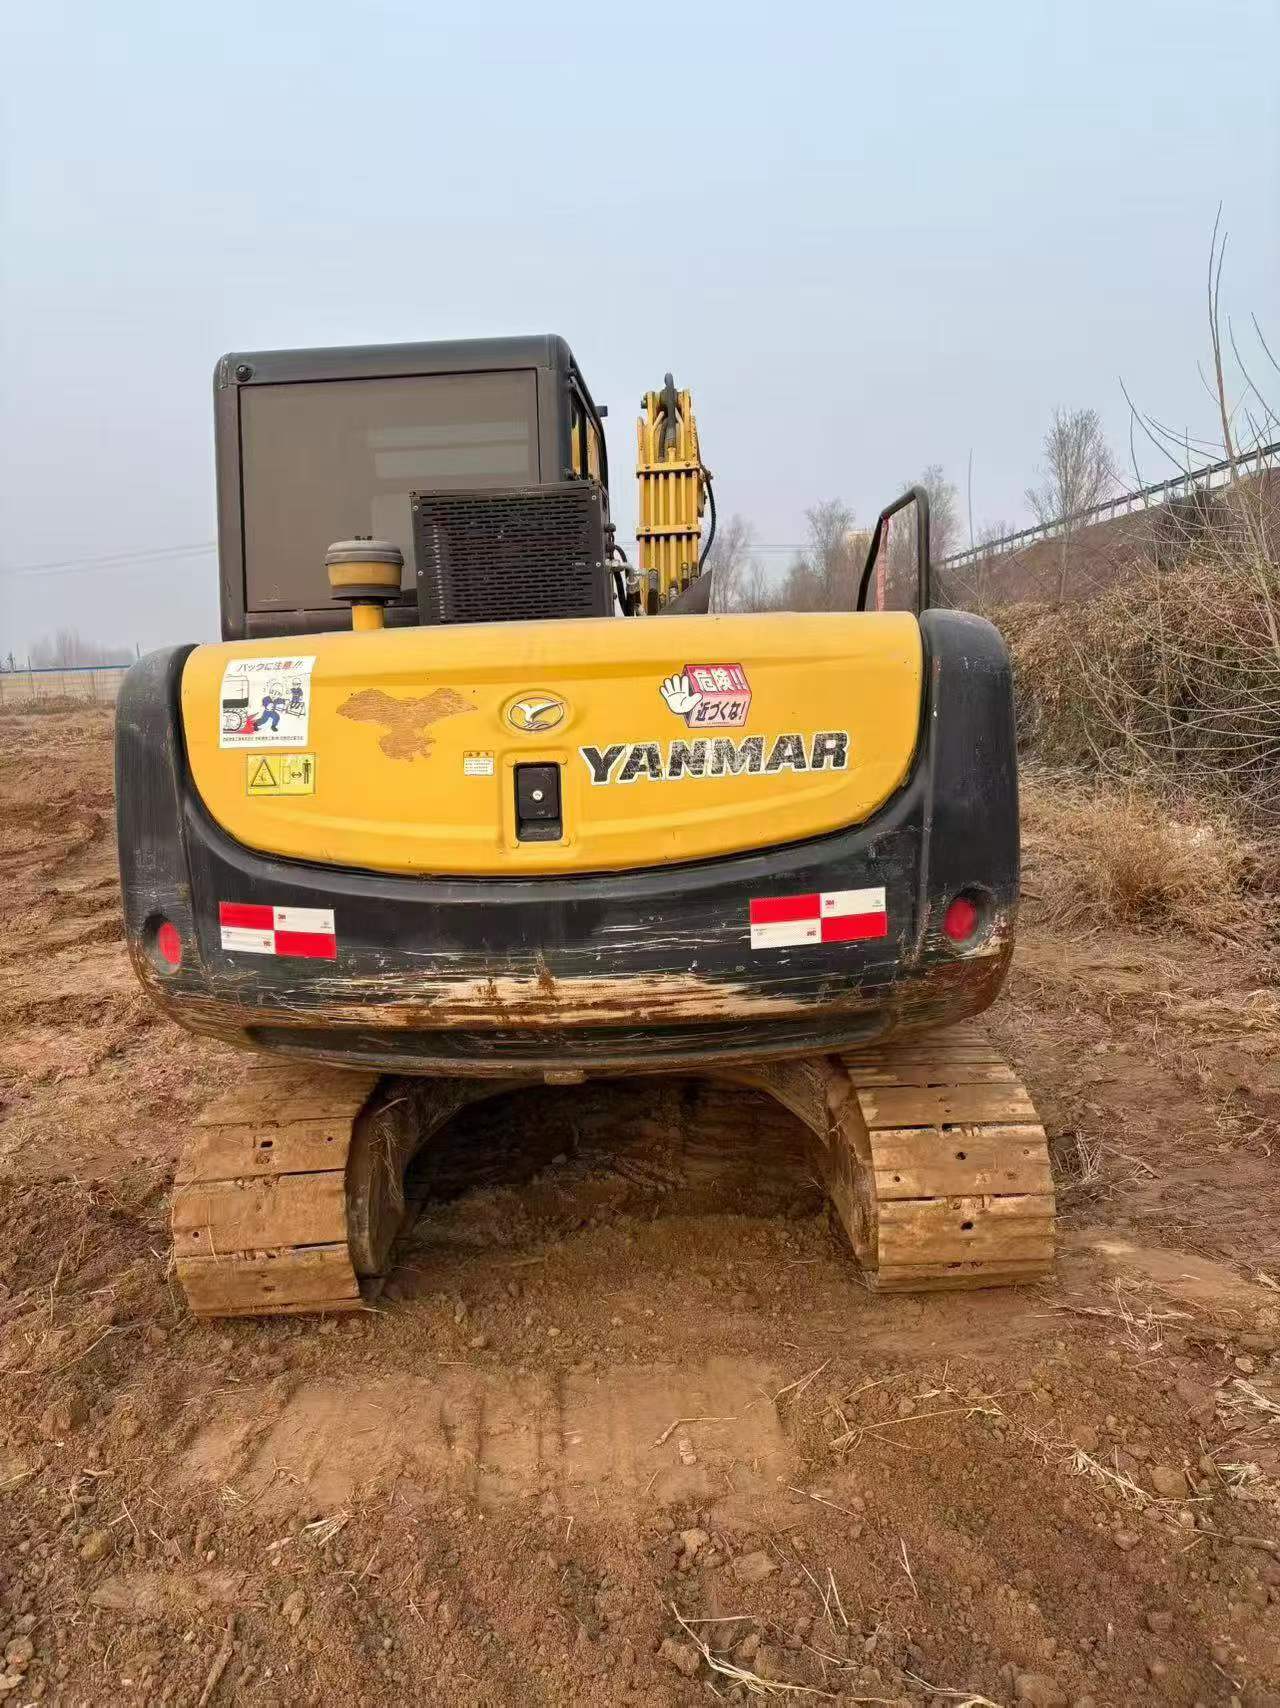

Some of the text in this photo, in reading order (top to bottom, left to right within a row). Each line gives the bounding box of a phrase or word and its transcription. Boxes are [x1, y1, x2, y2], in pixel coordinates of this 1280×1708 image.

[695, 701, 746, 721] 近づくな!
[580, 732, 849, 784] YANMAR
